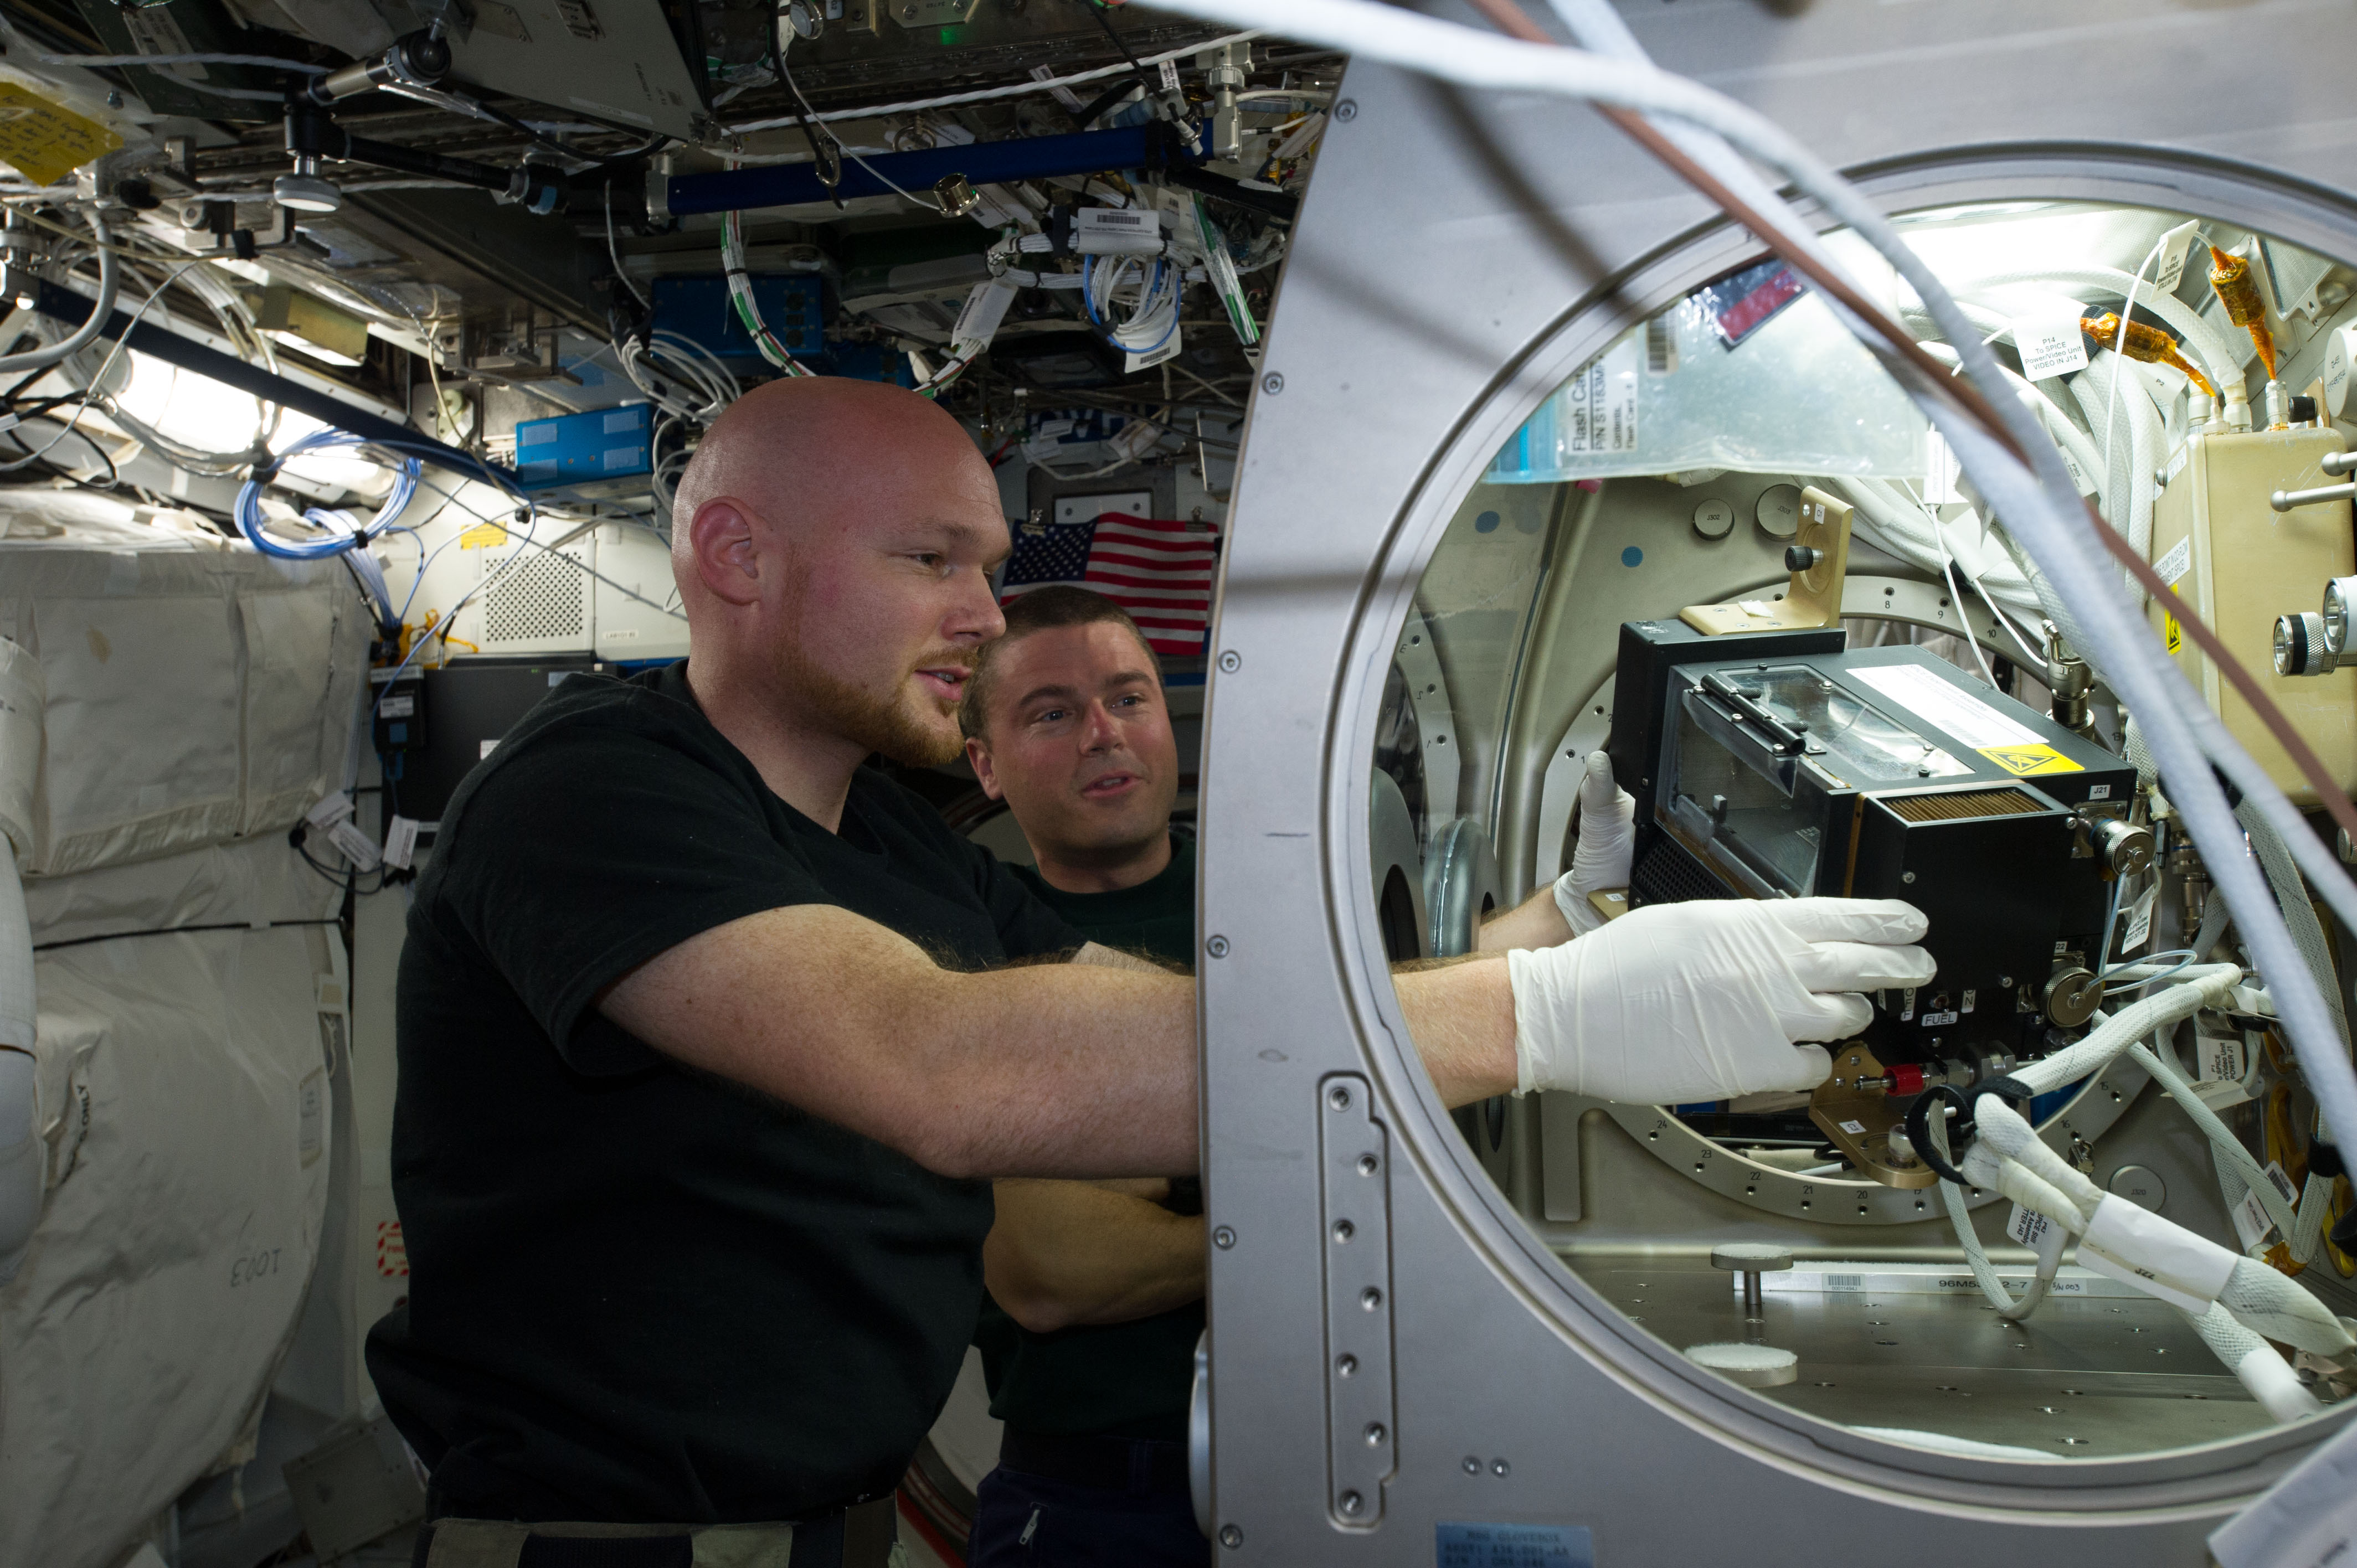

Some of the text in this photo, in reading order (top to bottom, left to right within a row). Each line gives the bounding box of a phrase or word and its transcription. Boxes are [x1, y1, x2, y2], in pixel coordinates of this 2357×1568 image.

[2169, 260, 2180, 271] SPICE
[2042, 337, 2056, 345] P14
[2045, 342, 2067, 352] SPICE
[2025, 351, 2066, 364] Power/Video
[2033, 360, 2055, 370] VIDEO
[2066, 354, 2078, 363] J14
[2156, 379, 2165, 387] P2
[1571, 372, 1587, 451] Flash Ca
[2072, 463, 2081, 477] P303
[1777, 506, 1791, 514] J303
[1816, 509, 1822, 518] C1
[2162, 556, 2171, 571] POINT
[1885, 600, 1891, 609] 8
[1938, 611, 1943, 619] 9
[1987, 629, 1996, 638] 10
[1903, 988, 1915, 1019] OFF
[1925, 1014, 1954, 1025] FUEL
[2099, 1082, 2108, 1090] 15
[2061, 1120, 2070, 1129] 16
[1750, 1172, 1762, 1180] 22
[1856, 1190, 1868, 1199] 20
[2021, 1216, 2034, 1245] Assembly
[2030, 1213, 2044, 1244] SPICE Still
[1939, 1280, 2027, 1288] 96M52-7
[2052, 1282, 2063, 1291] S/N
[1497, 1531, 1560, 1543] GLOVEBOX
